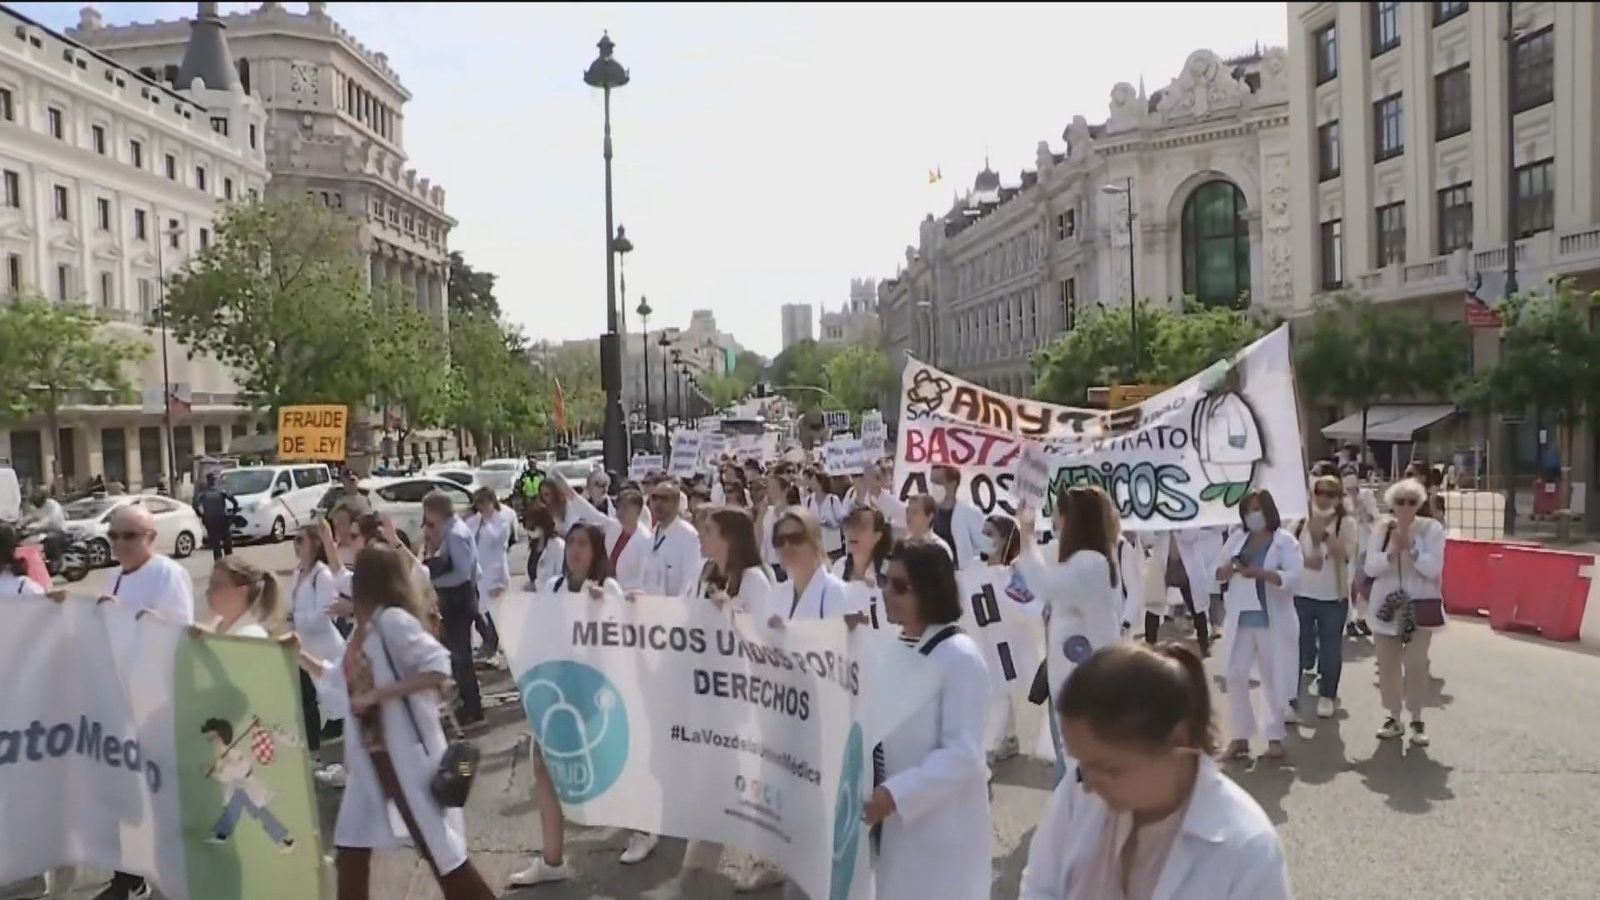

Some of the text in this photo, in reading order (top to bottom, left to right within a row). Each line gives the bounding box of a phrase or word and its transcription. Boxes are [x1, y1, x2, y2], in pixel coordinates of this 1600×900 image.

[282, 411, 343, 428] FRAUDE
[283, 436, 305, 453] DE
[572, 616, 706, 654] MÉDICOS
[694, 669, 810, 720] DERECHOS
